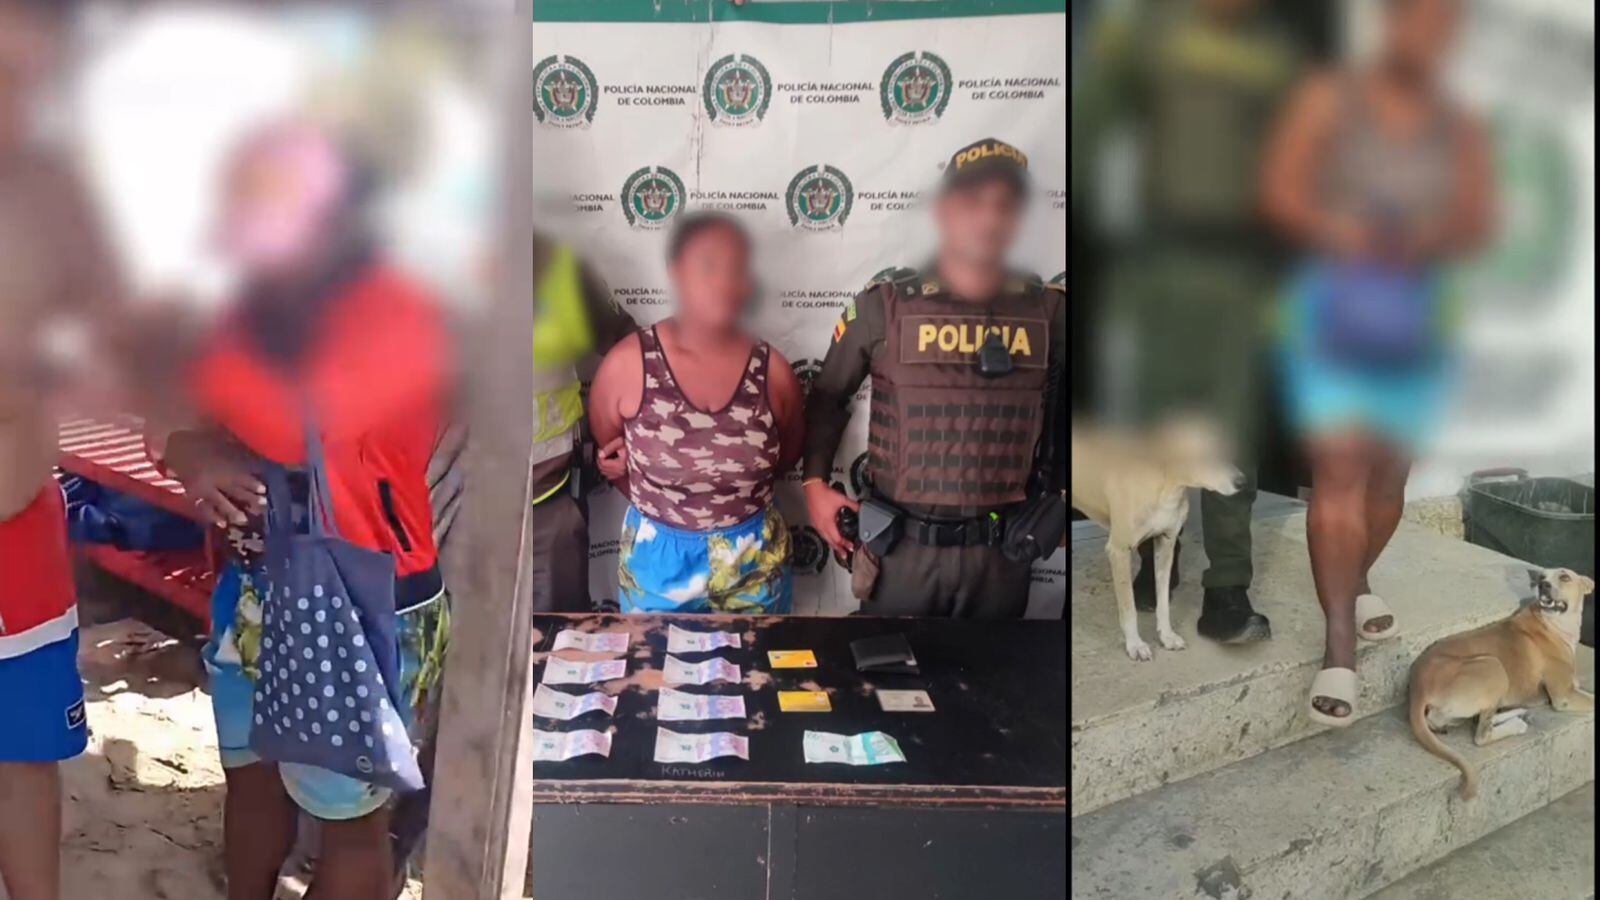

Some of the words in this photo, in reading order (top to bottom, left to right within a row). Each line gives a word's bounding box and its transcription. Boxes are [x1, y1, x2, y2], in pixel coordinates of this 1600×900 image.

[777, 82, 818, 92] POLICÍA
[820, 82, 875, 91] NACIONAL
[958, 79, 1002, 89] POLICÍA
[1004, 77, 1061, 87] NACIONAL
[604, 85, 644, 94] POLICÍA
[646, 85, 697, 94] NACIONAL
[790, 95, 804, 103] DE
[806, 95, 860, 103] COLOMBIA
[972, 92, 986, 100] DE
[988, 90, 1045, 99] COLOMBIA
[617, 97, 631, 106] DE
[633, 97, 686, 106] COLOMBIA
[573, 193, 615, 201] ACIONAL
[690, 190, 727, 200] POLICÍA
[729, 191, 779, 200] NACIONAL
[858, 190, 898, 199] POLICÍA
[702, 202, 715, 210] DE
[717, 202, 767, 210] COLOMBIA
[870, 202, 883, 210] DE
[614, 287, 649, 296] POLICÍA
[782, 290, 807, 298] LICÍA
[808, 290, 857, 299] NACIONAL
[626, 297, 638, 305] DE
